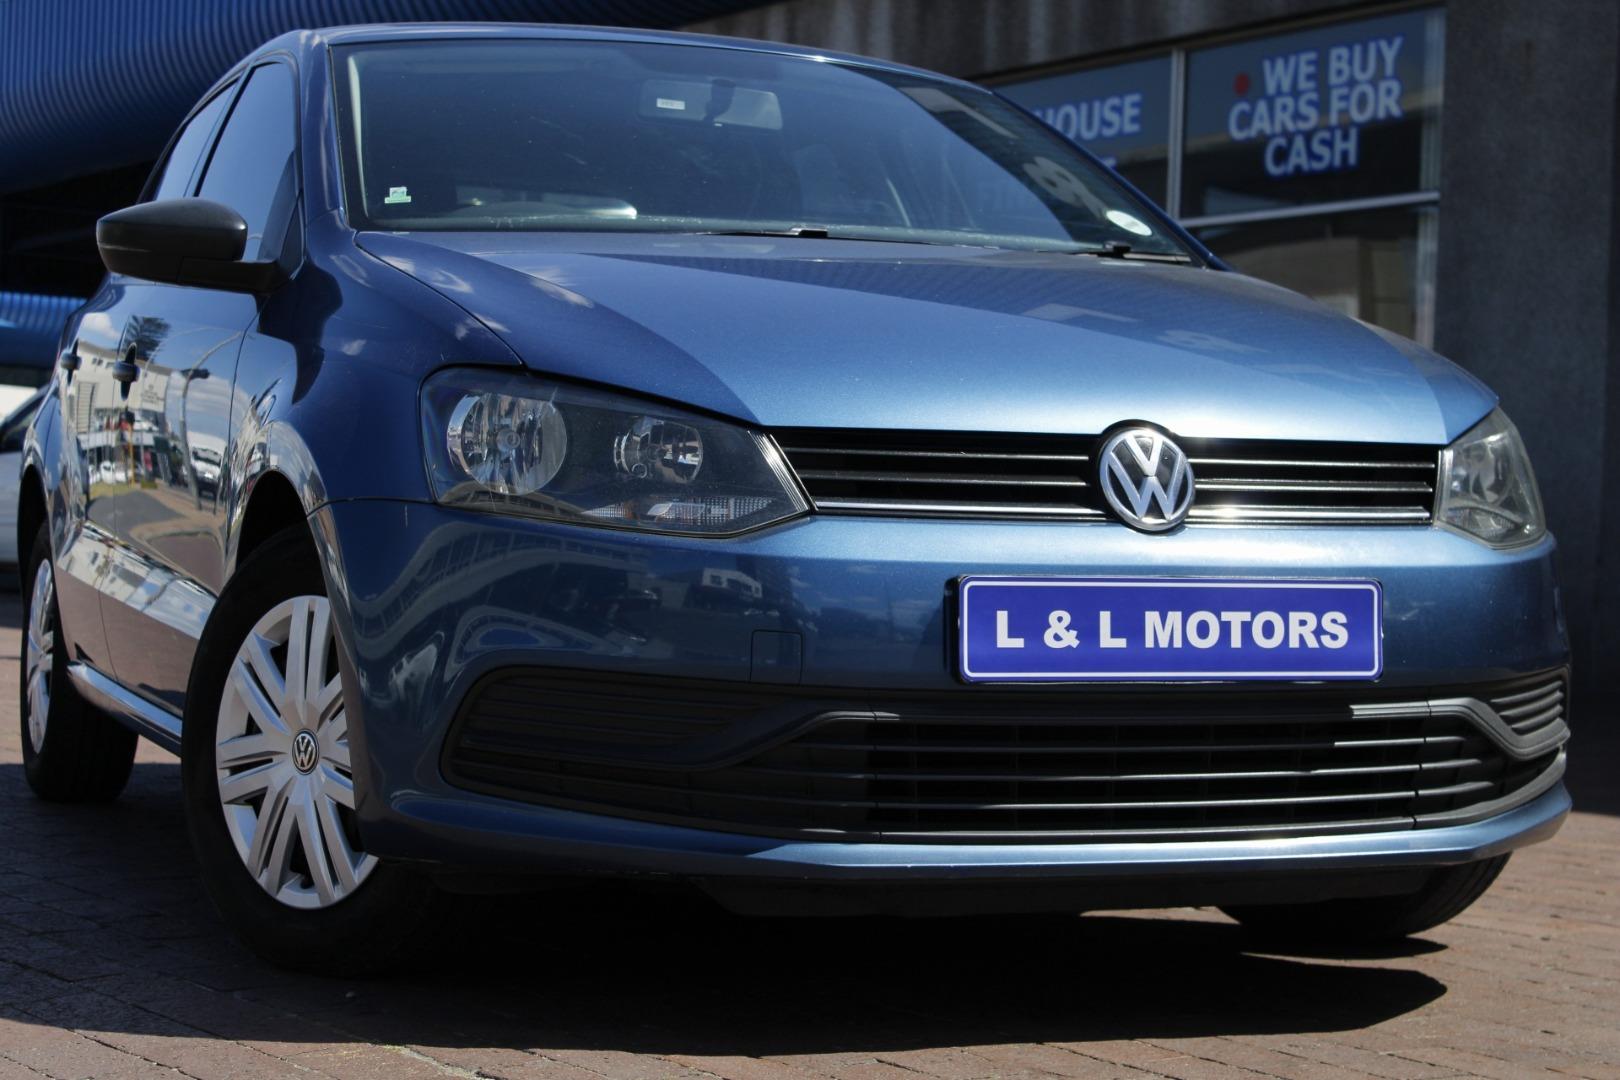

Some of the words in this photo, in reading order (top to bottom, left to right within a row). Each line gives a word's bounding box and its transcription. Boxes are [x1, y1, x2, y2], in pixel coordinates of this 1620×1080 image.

[1264, 51, 1318, 97] WE
[1329, 36, 1404, 85] BUY
[1229, 92, 1318, 141] CARS
[1329, 80, 1403, 126] FOR
[1265, 127, 1358, 176] CASH
[1103, 429, 1190, 526] VW
[996, 611, 1025, 648] L
[1044, 610, 1080, 649] &
[1100, 611, 1127, 648] L
[1145, 610, 1349, 649] MOTORS
